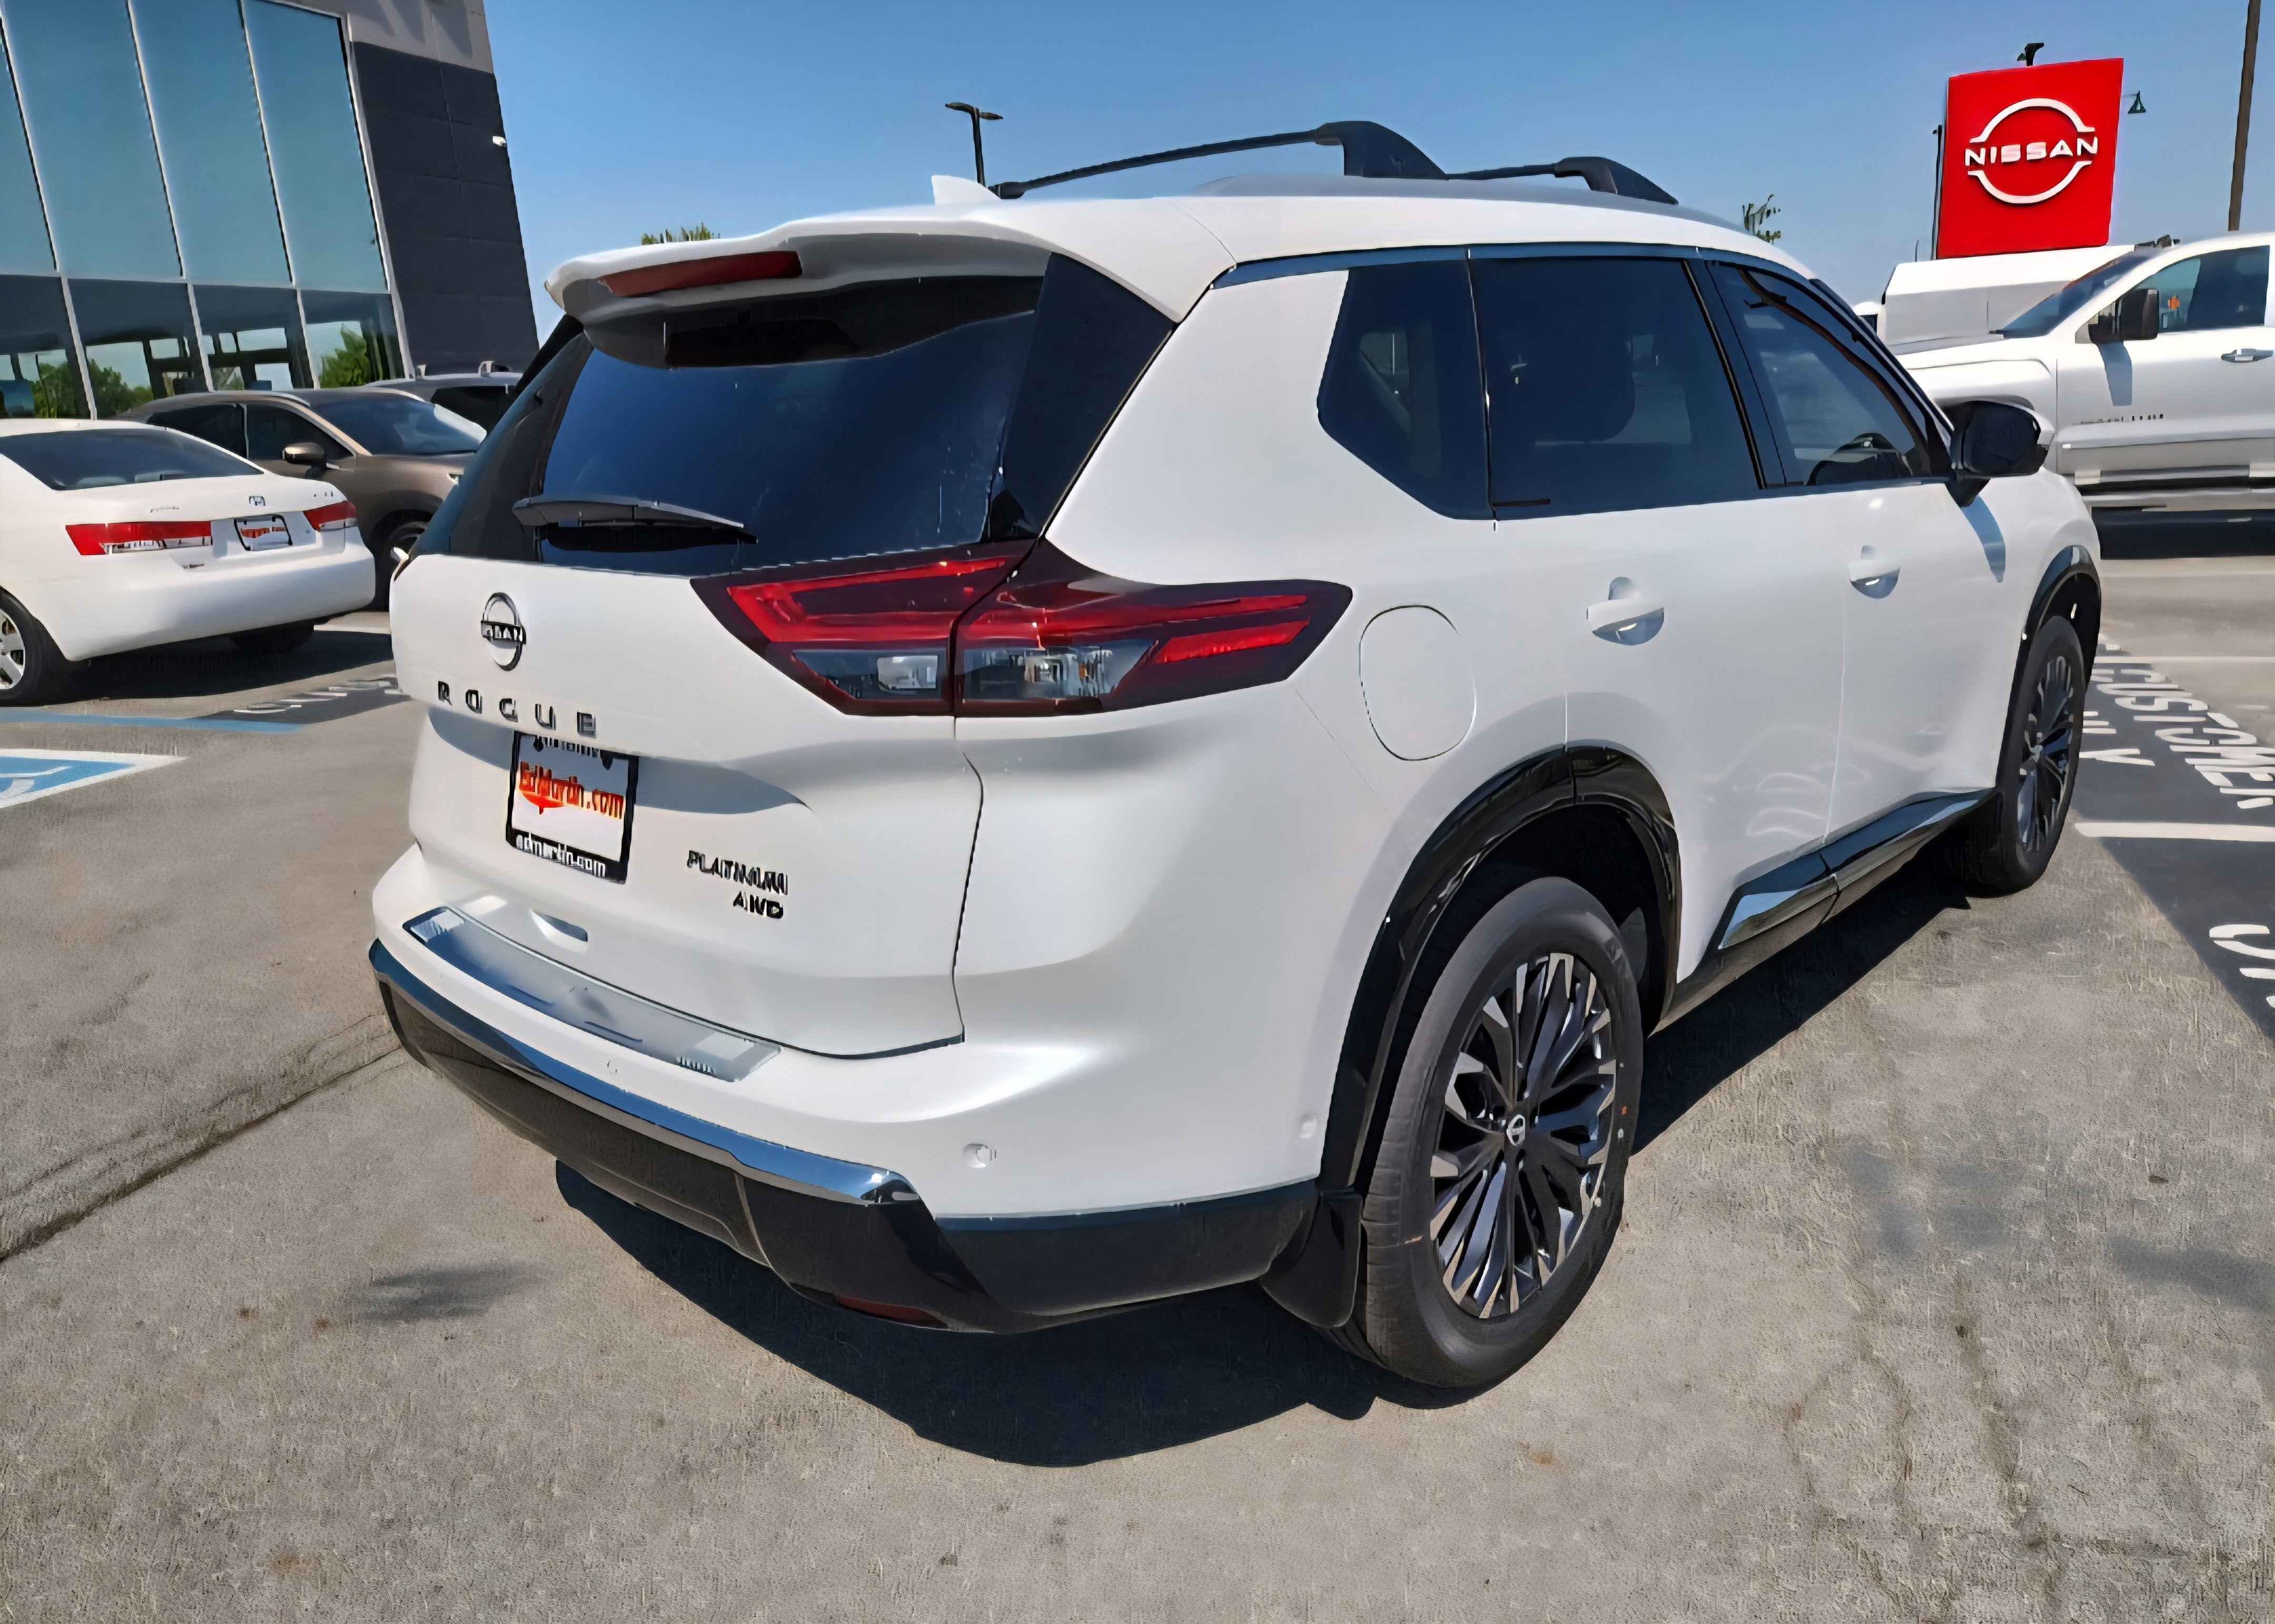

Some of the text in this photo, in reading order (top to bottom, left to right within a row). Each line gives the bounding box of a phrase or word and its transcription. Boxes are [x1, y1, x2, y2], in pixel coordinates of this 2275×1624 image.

[1965, 137, 2098, 166] NISSAN
[438, 680, 596, 738] ROGUE
[733, 890, 784, 919] AWD
